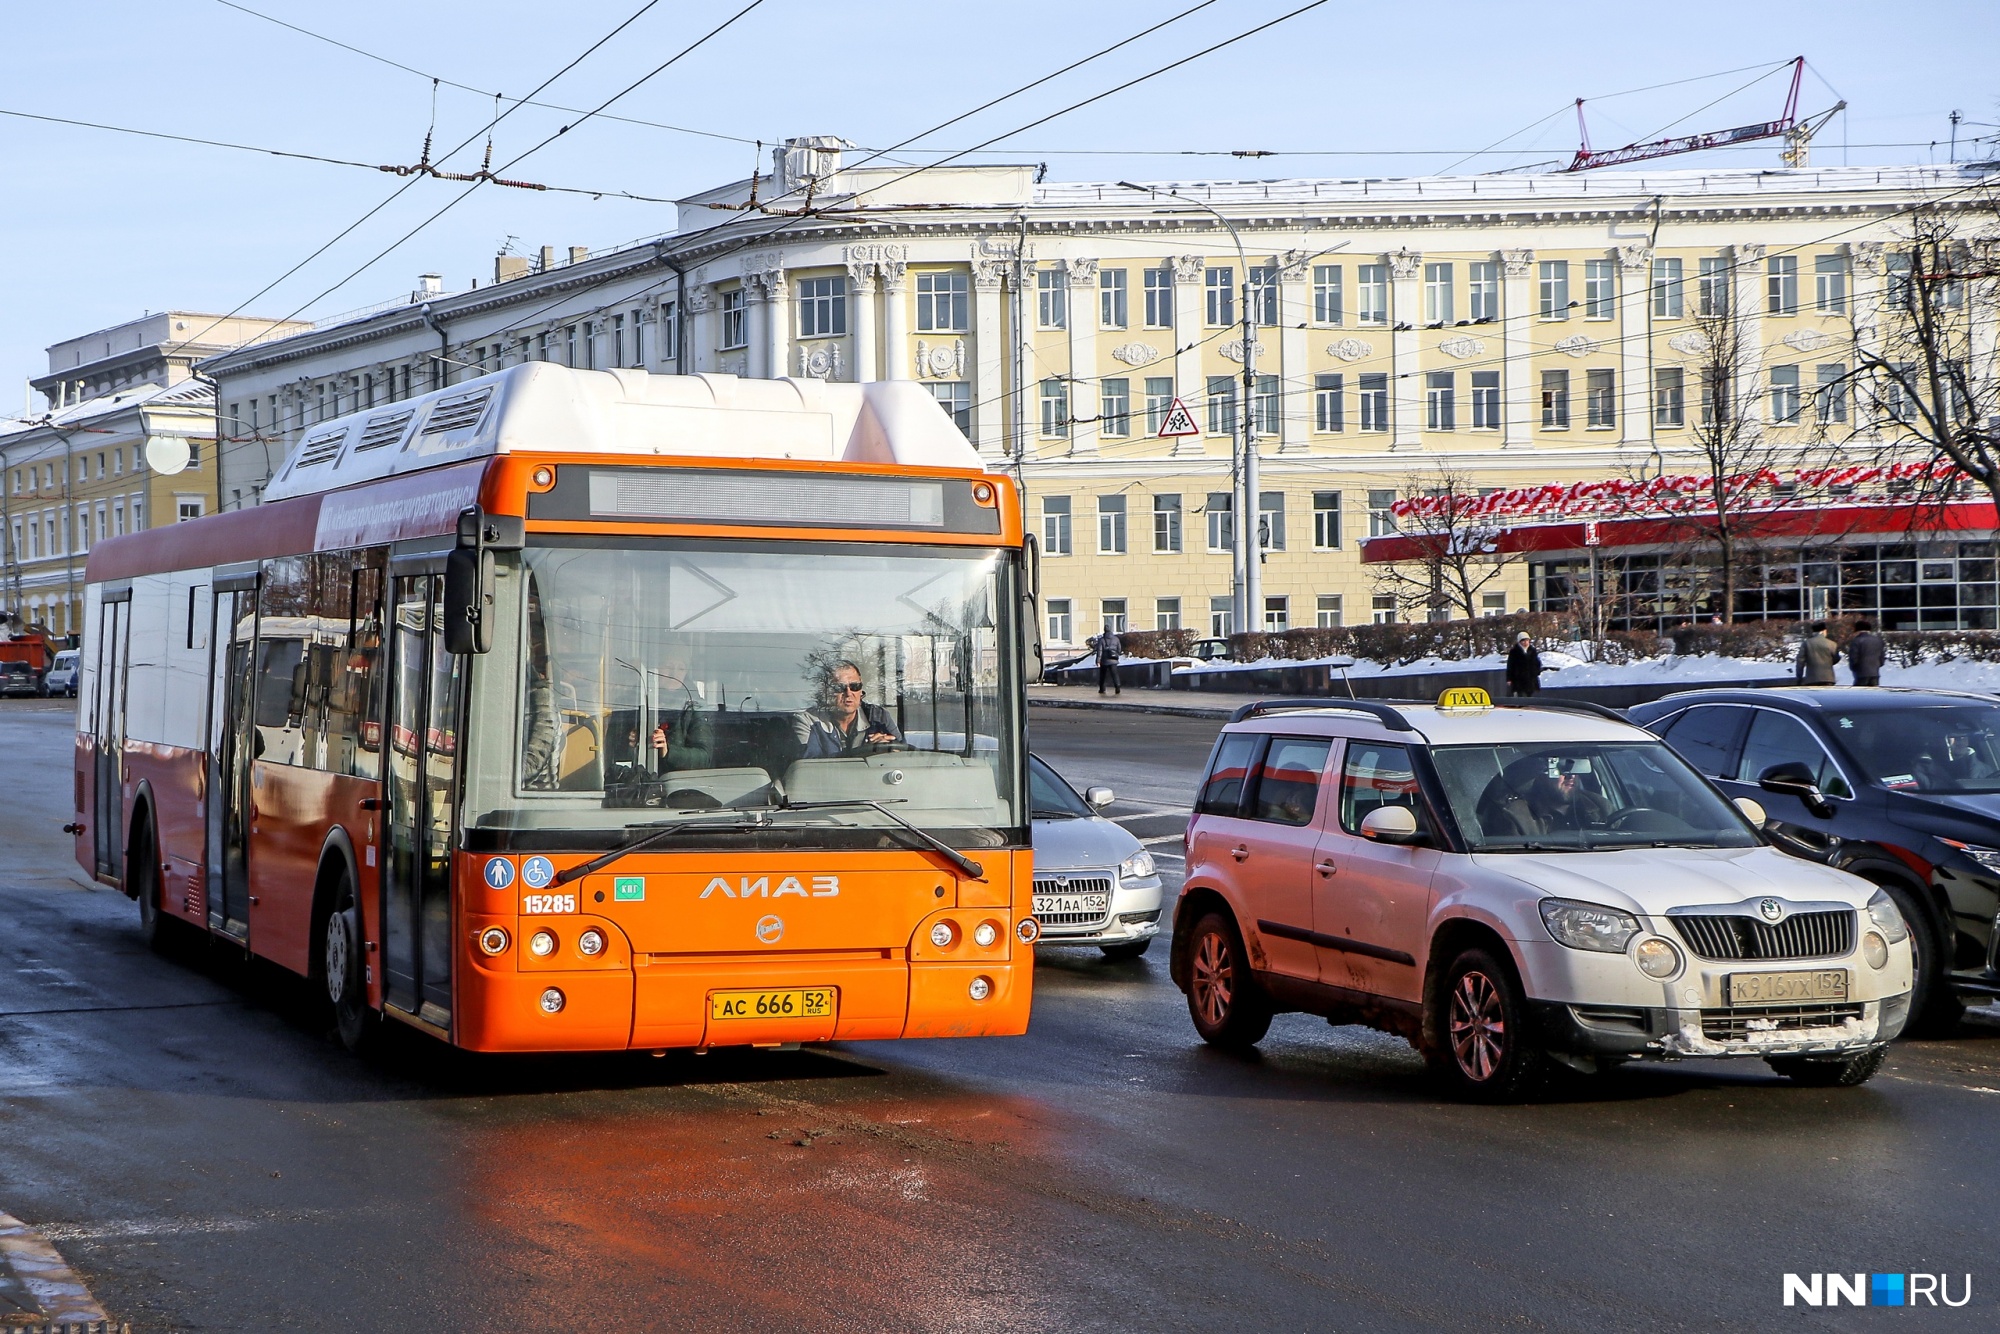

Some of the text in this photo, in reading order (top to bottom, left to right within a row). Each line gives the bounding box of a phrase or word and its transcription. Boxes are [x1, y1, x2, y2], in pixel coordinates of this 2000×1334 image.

[1450, 692, 1484, 705] TAXI
[621, 885, 638, 893] КПГ
[699, 876, 839, 899] ЛИАЗ
[524, 895, 575, 913] 15285
[1083, 896, 1103, 906] 152
[1737, 973, 1842, 998] К916УХ 152
[723, 993, 824, 1015] АС 666 52
